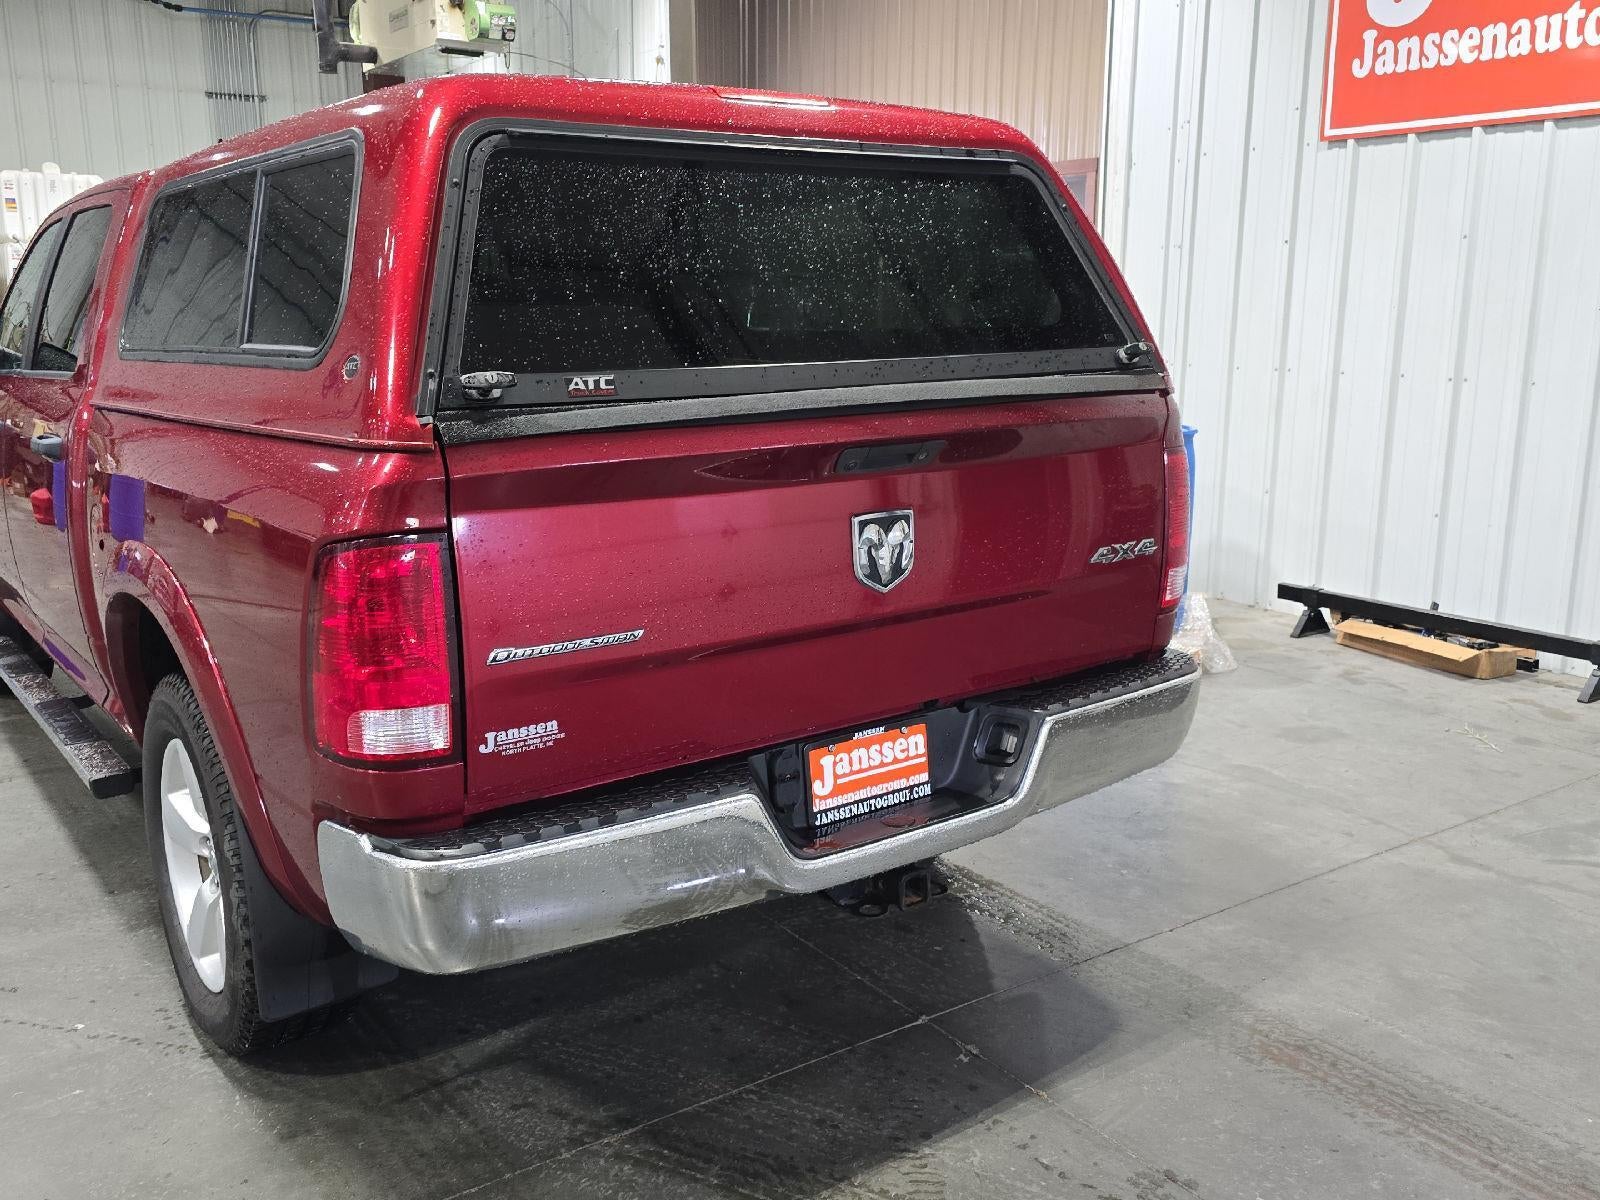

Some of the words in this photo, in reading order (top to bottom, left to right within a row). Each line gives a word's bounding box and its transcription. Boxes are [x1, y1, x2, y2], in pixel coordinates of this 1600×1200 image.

[568, 375, 614, 391] ATC
[479, 720, 558, 753] Janssen
[852, 726, 886, 740] JANSSEN
[813, 733, 926, 796] Janssen
[815, 783, 931, 826] JANSSENAUTOGROUP.COM
